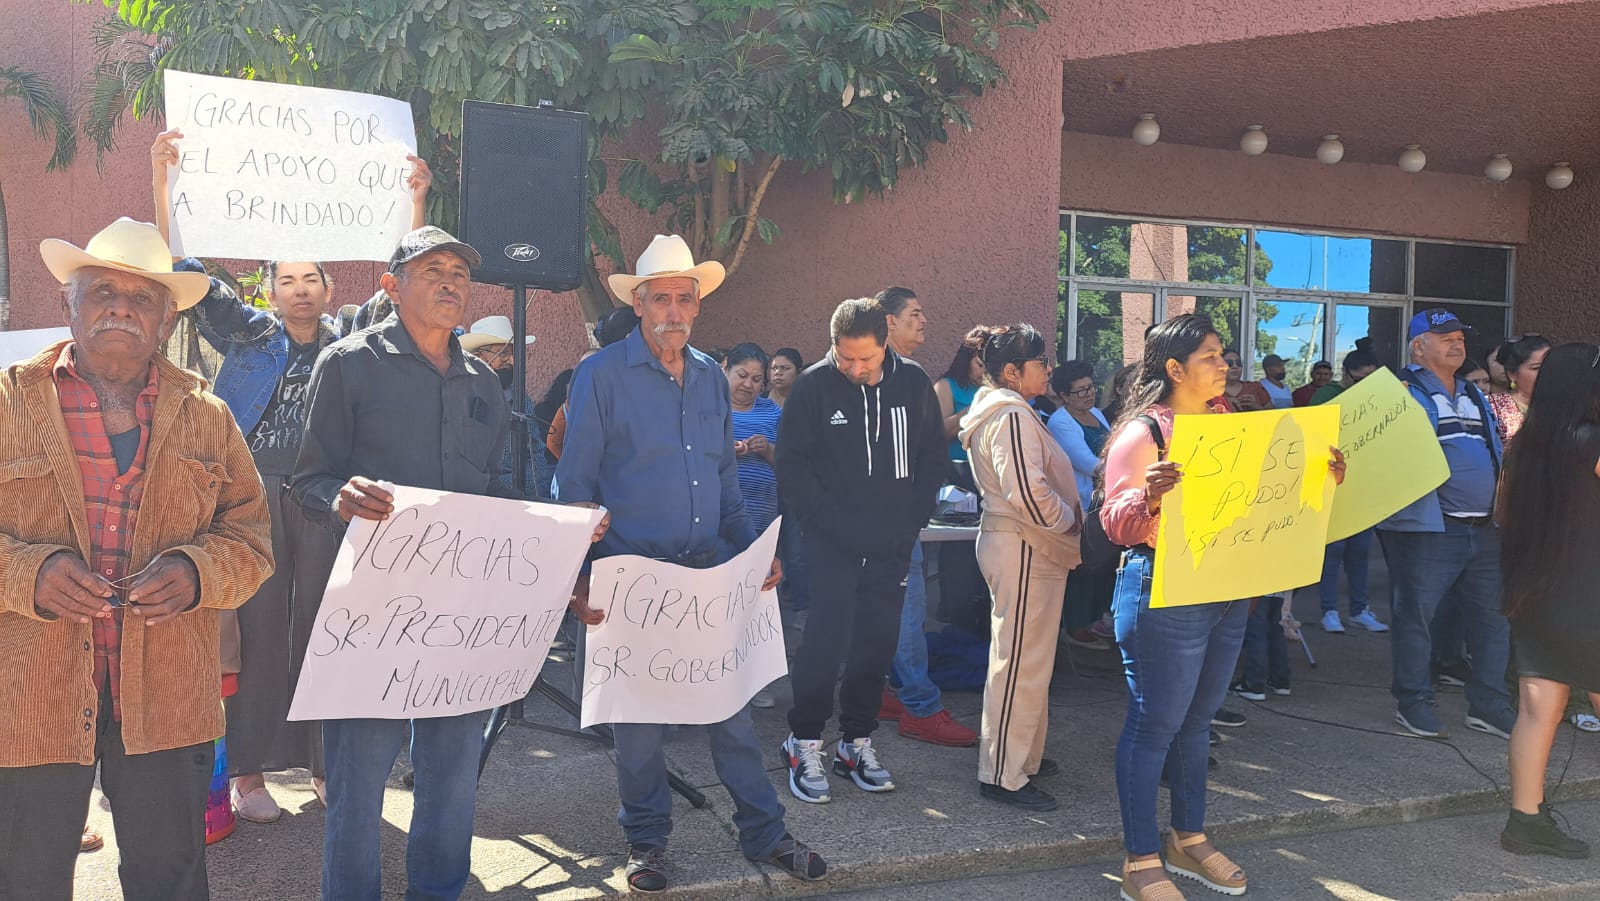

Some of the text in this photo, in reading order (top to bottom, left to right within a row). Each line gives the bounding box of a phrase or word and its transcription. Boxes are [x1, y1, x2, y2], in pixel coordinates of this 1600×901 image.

[334, 110, 384, 146] POR
[180, 147, 415, 195] EL APOYO QUE
[173, 189, 396, 236] A BRINDADO!
[1261, 438, 1305, 472] SE
[1211, 474, 1300, 521] PUDO!
[1229, 527, 1256, 547] SE
[375, 595, 566, 650] PRESIDENTE
[589, 604, 780, 686] SR. GOBERNADOR
